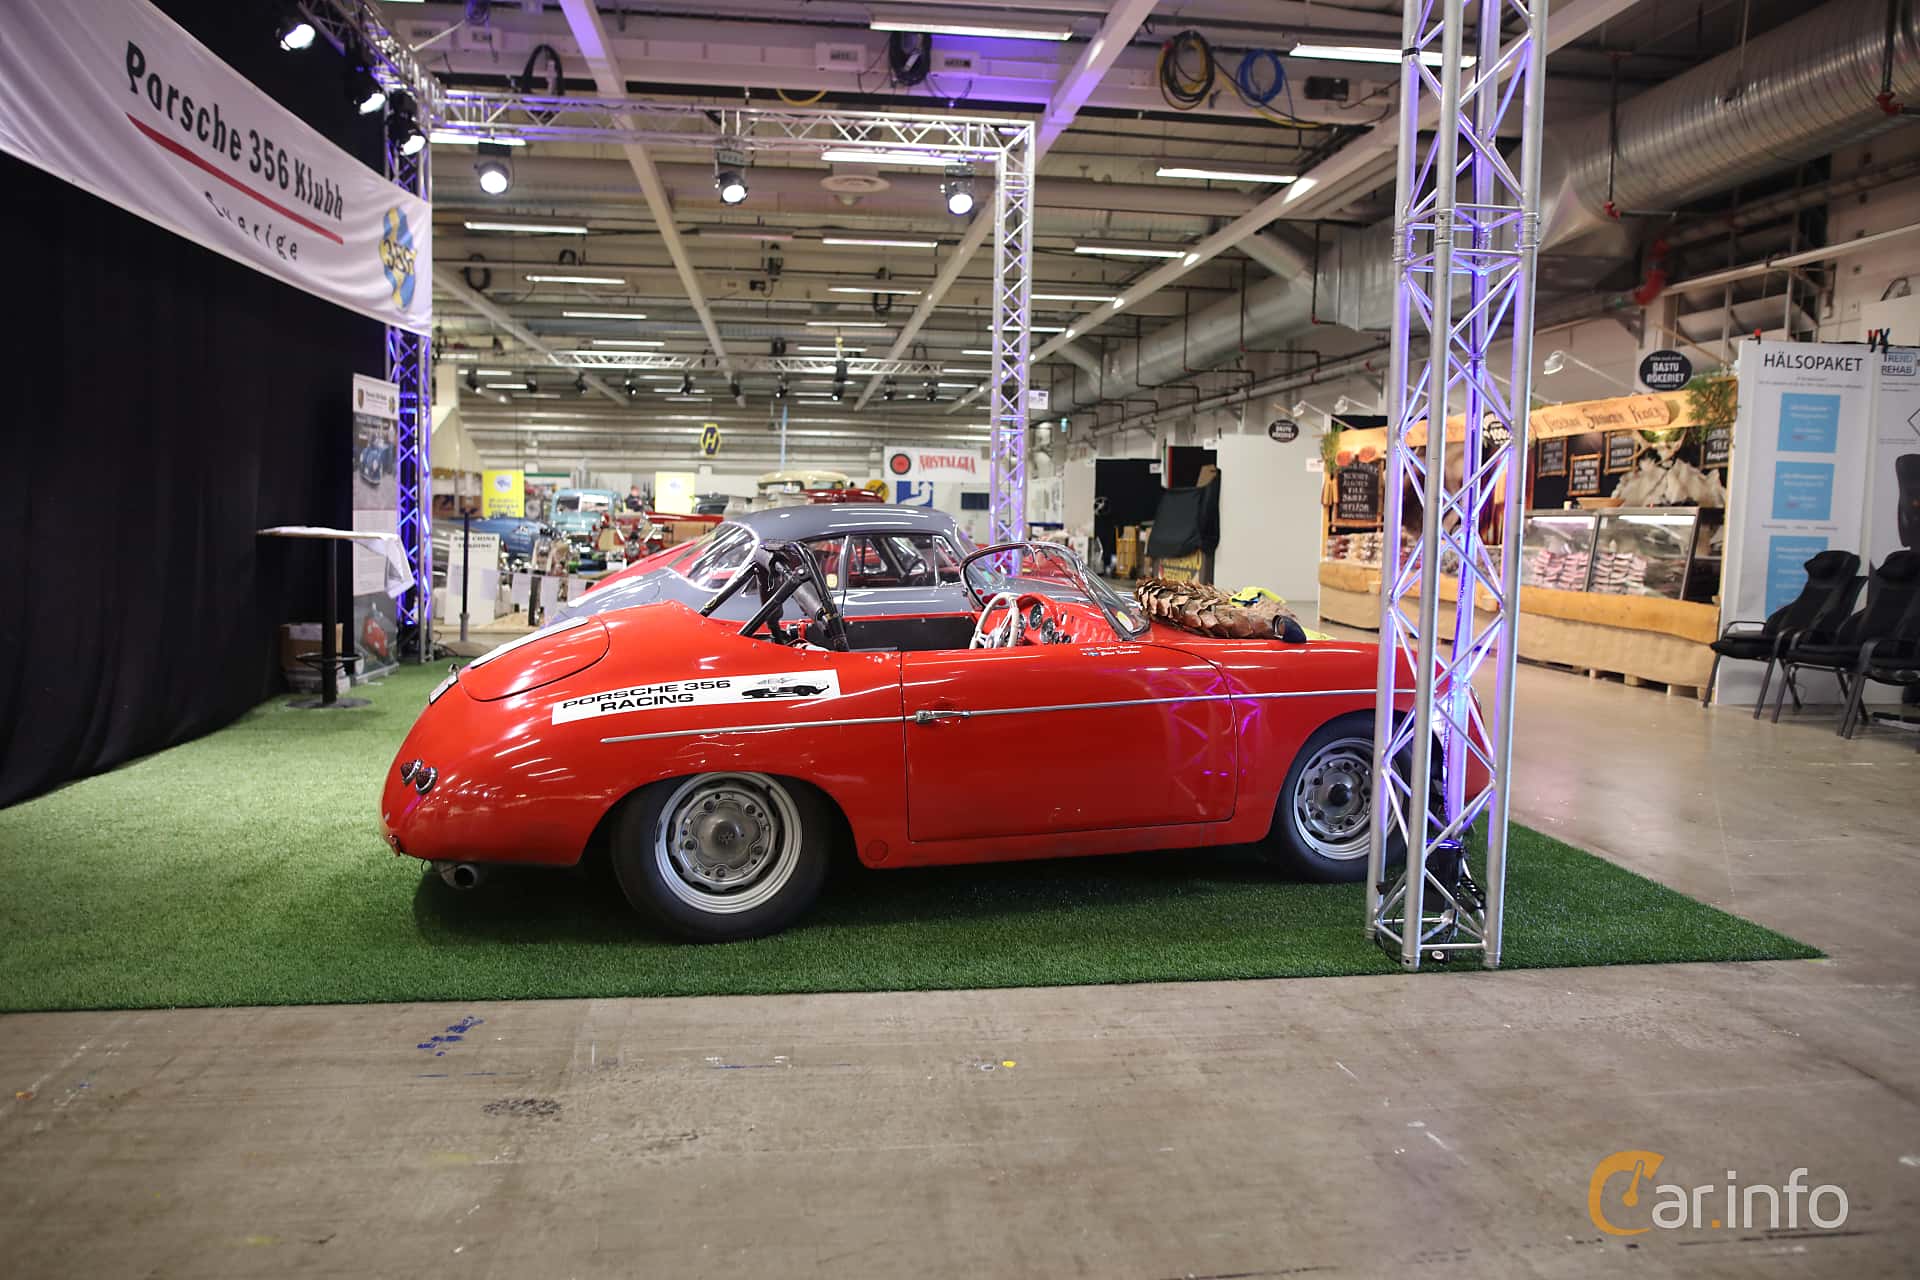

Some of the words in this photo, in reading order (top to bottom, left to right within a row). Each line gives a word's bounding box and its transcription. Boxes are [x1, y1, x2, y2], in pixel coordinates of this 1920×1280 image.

[126, 40, 242, 161] Porsche
[250, 129, 289, 190] 356
[1763, 351, 1864, 372] HÄLSOPAKET
[563, 684, 679, 709] PORSCHE
[684, 680, 731, 691] 356
[600, 693, 695, 712] RACING
